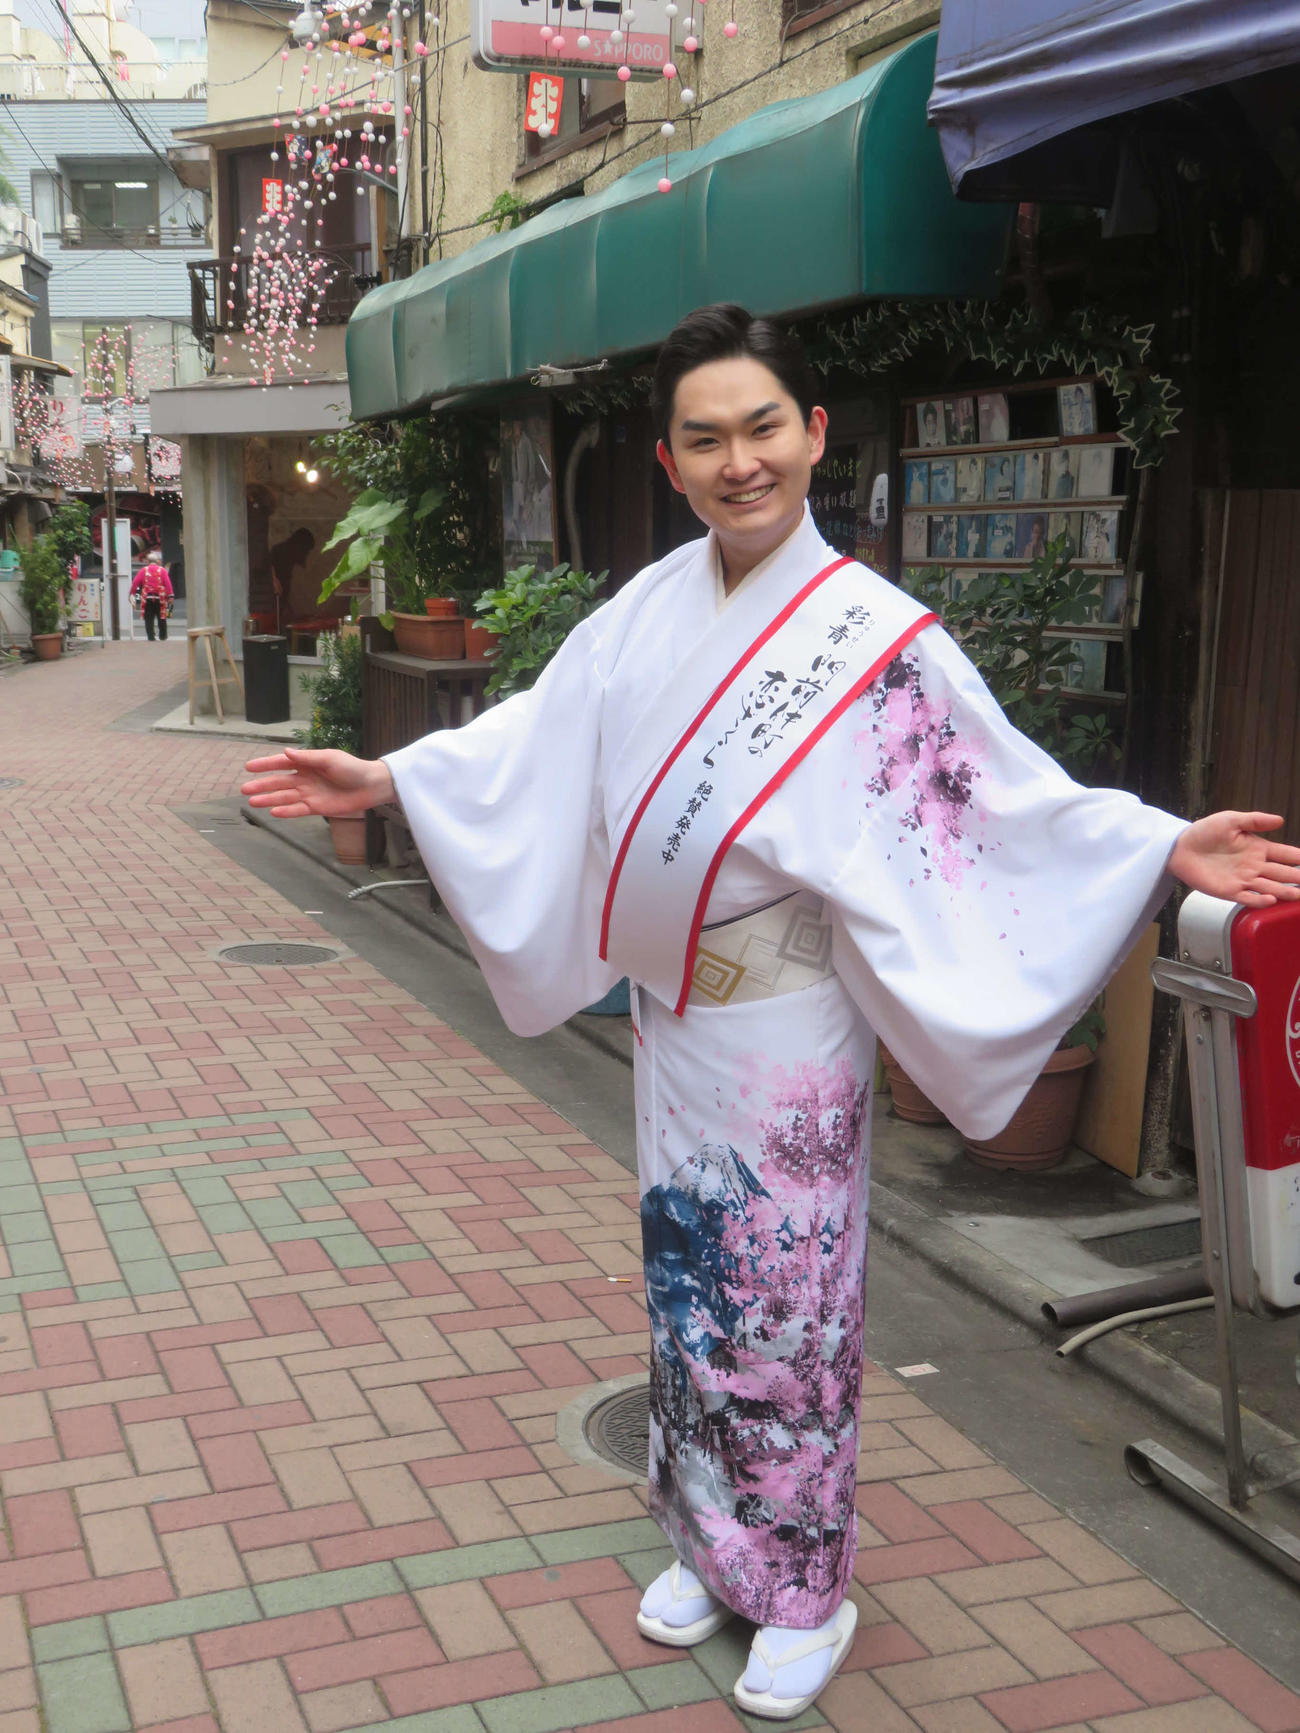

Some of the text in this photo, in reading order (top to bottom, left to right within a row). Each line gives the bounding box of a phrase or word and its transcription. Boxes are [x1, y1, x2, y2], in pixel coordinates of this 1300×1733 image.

[827, 605, 871, 645] 彩青
[748, 653, 847, 758] 門前仲町の
[661, 780, 714, 866] 絶賛発売中
